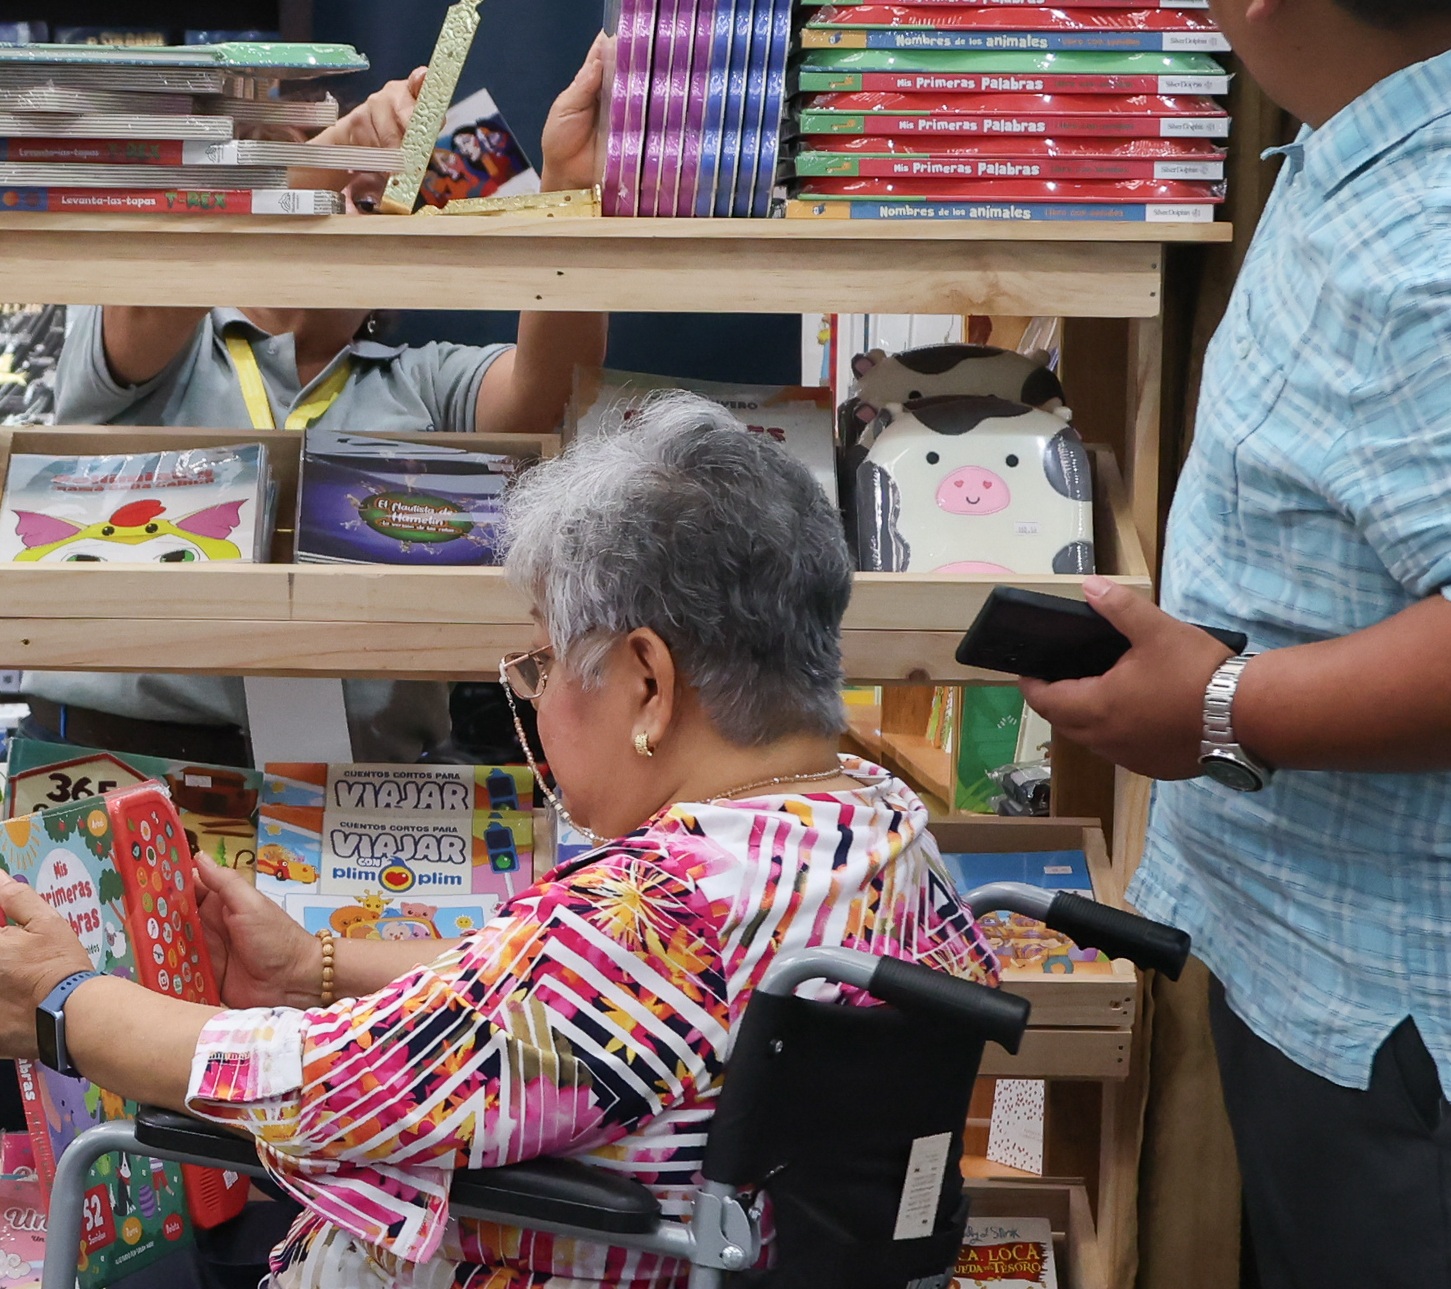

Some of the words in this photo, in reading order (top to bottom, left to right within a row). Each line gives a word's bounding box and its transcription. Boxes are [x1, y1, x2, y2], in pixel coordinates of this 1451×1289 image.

[897, 78, 912, 88] Mis
[916, 76, 976, 90] Primeras
[981, 77, 1043, 91] Palabras
[61, 195, 156, 208] Levanta-las-tapas
[165, 192, 227, 209] T-REX
[378, 499, 388, 508] El
[343, 771, 388, 779] CUENTOS
[392, 771, 430, 779] CORTOS
[434, 771, 461, 781] PARA
[334, 779, 469, 810] VIAJAR
[340, 821, 386, 831] CUENTOS
[389, 822, 428, 831] CORTOS
[431, 823, 459, 833] PARA
[330, 830, 466, 865] VIAJAR
[53, 861, 68, 880] Mis
[356, 857, 382, 867] CON
[332, 866, 377, 884] plim
[418, 870, 463, 888] plim
[83, 1195, 104, 1231] 52
[988, 1243, 1040, 1261] LOCA
[989, 1261, 1041, 1274] TESORO
